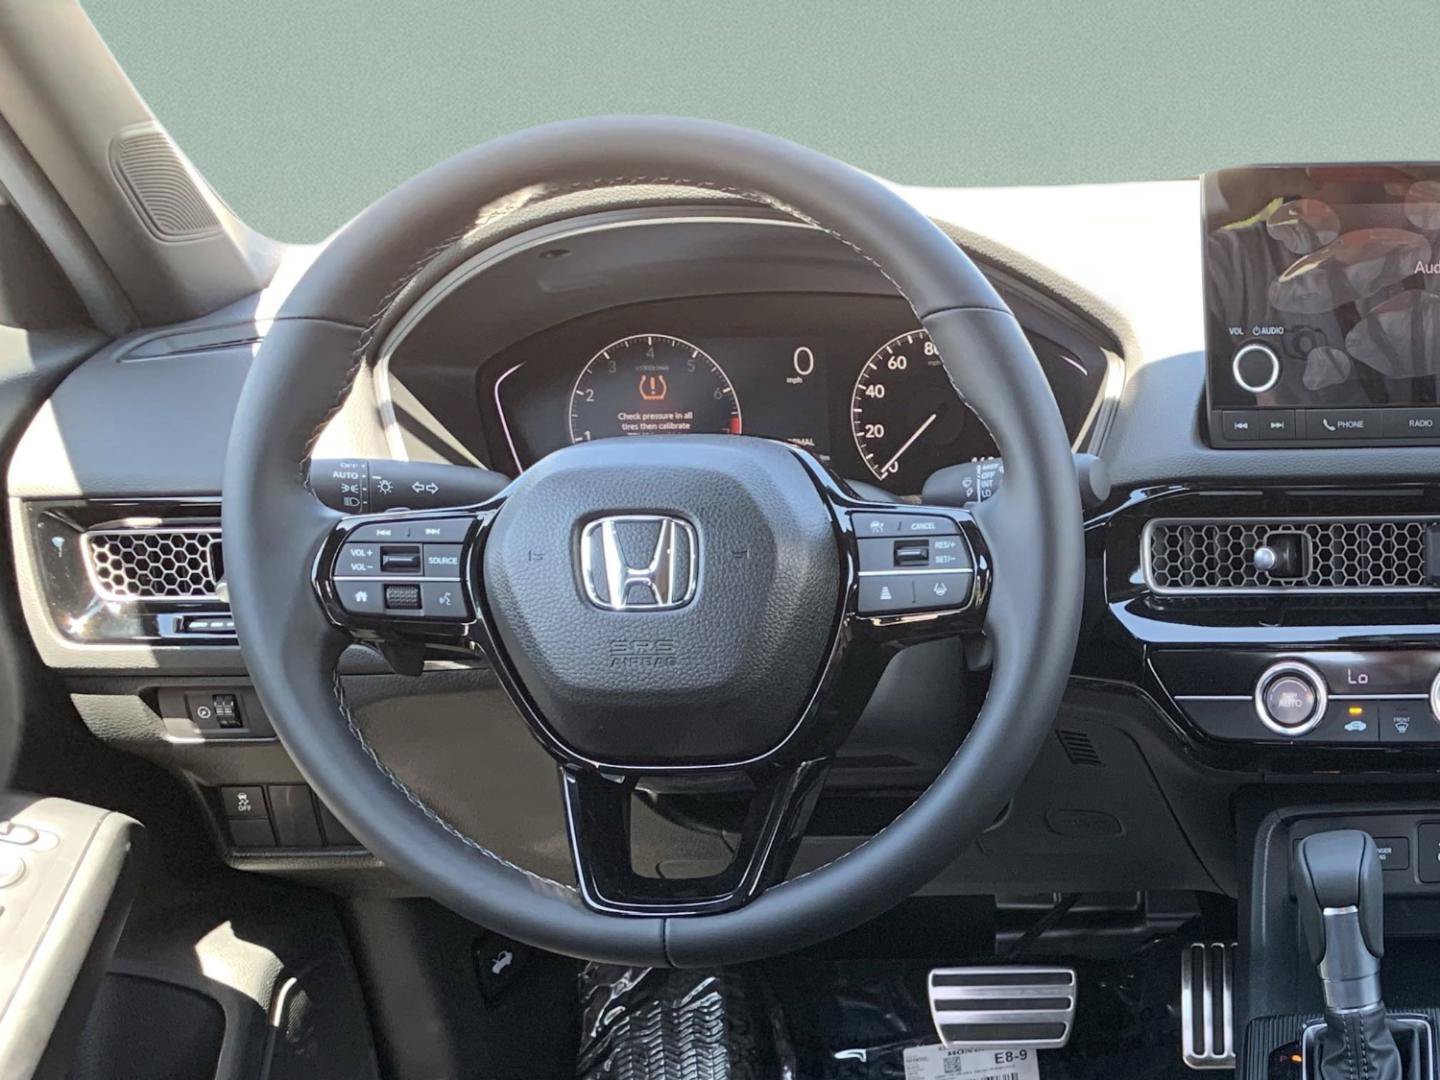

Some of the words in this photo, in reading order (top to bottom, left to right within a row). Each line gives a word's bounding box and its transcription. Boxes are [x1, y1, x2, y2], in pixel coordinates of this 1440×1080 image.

[1229, 327, 1244, 336] VOL
[1261, 326, 1284, 335] AUDIO
[646, 346, 655, 360] 4
[687, 359, 696, 373] 5
[793, 346, 814, 376] 0
[887, 354, 907, 371] 60
[608, 360, 617, 374] 3
[786, 376, 803, 384] mph
[585, 388, 595, 402] 2
[713, 390, 723, 400] 6
[865, 383, 885, 399] 40
[617, 411, 640, 421] Check
[641, 412, 675, 423] pressure
[676, 411, 683, 420] in
[684, 410, 693, 420] all
[621, 420, 640, 431] tires
[640, 420, 658, 430] then
[658, 420, 691, 430] calibrate
[1337, 420, 1364, 430] PHONE
[1409, 418, 1433, 428] RADIO
[584, 430, 591, 440] 1
[865, 424, 885, 439] 20
[333, 471, 359, 480] AUTO
[981, 471, 996, 479] OFF
[981, 489, 991, 498] LO
[911, 522, 936, 530] CANCEL
[350, 549, 366, 557] VOL
[428, 557, 458, 565] SOURCE
[609, 638, 674, 655] SRS
[1347, 668, 1368, 684] Lo
[1278, 699, 1303, 708] AUTO
[994, 1049, 1028, 1064] E8-9
